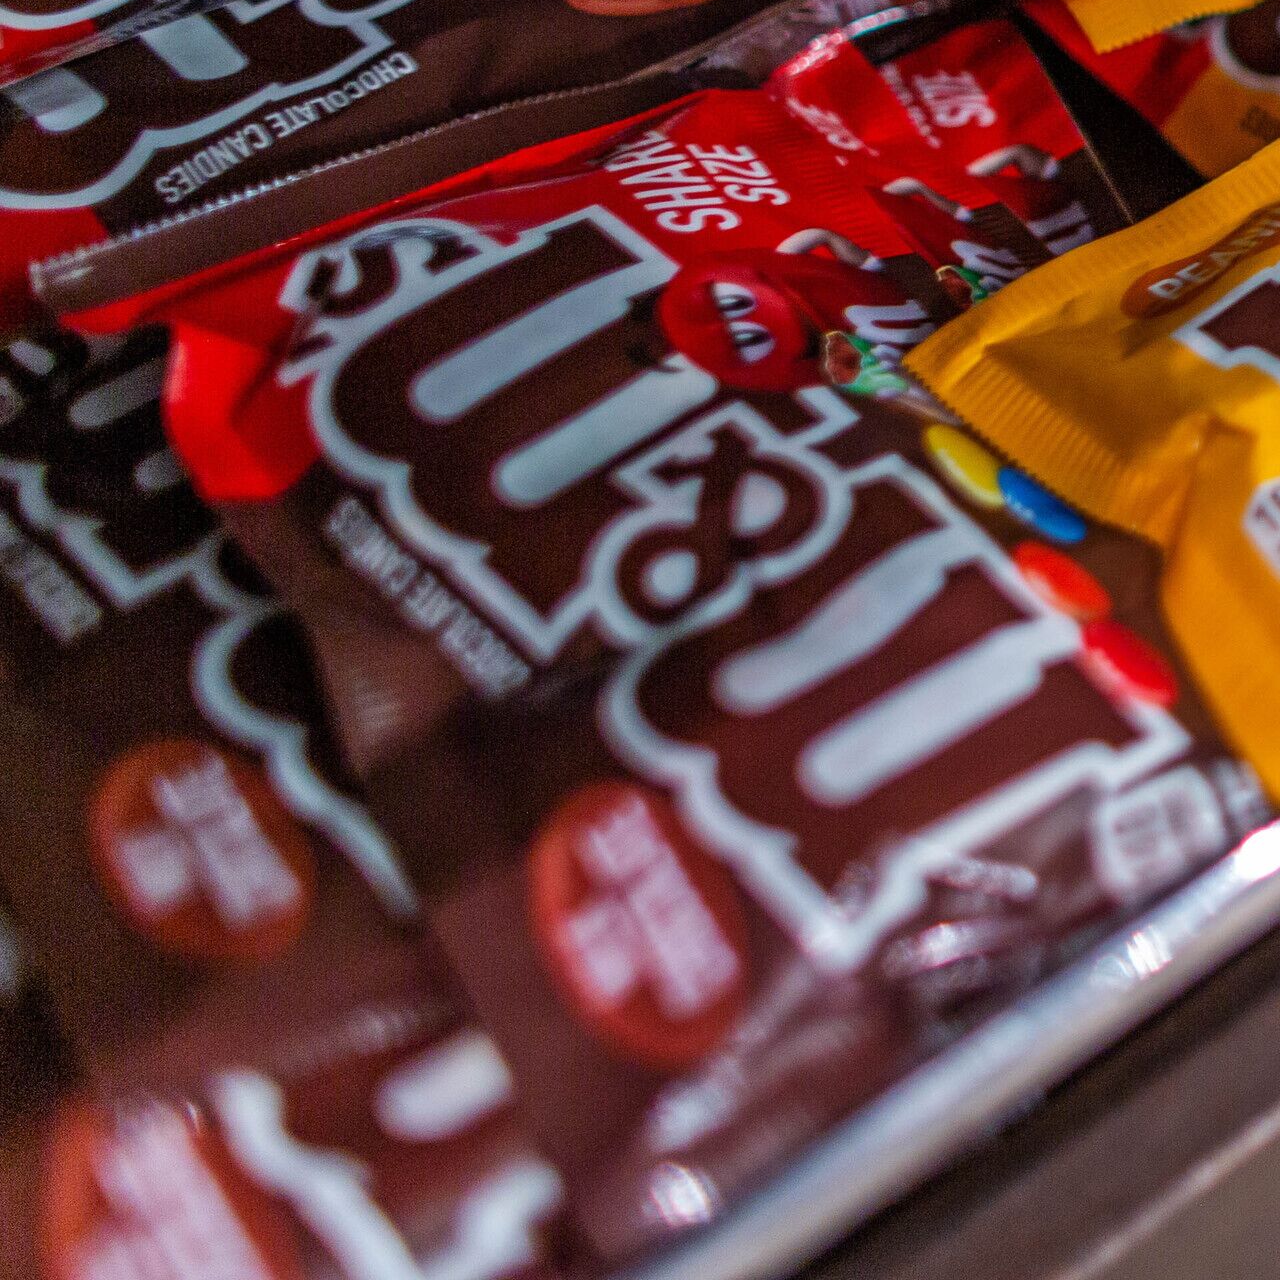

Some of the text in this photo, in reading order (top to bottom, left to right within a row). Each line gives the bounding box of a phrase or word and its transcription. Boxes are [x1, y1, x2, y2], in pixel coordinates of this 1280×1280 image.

[154, 48, 420, 206] CHOCOLATE CANDIES
[688, 144, 792, 207] SIZE
